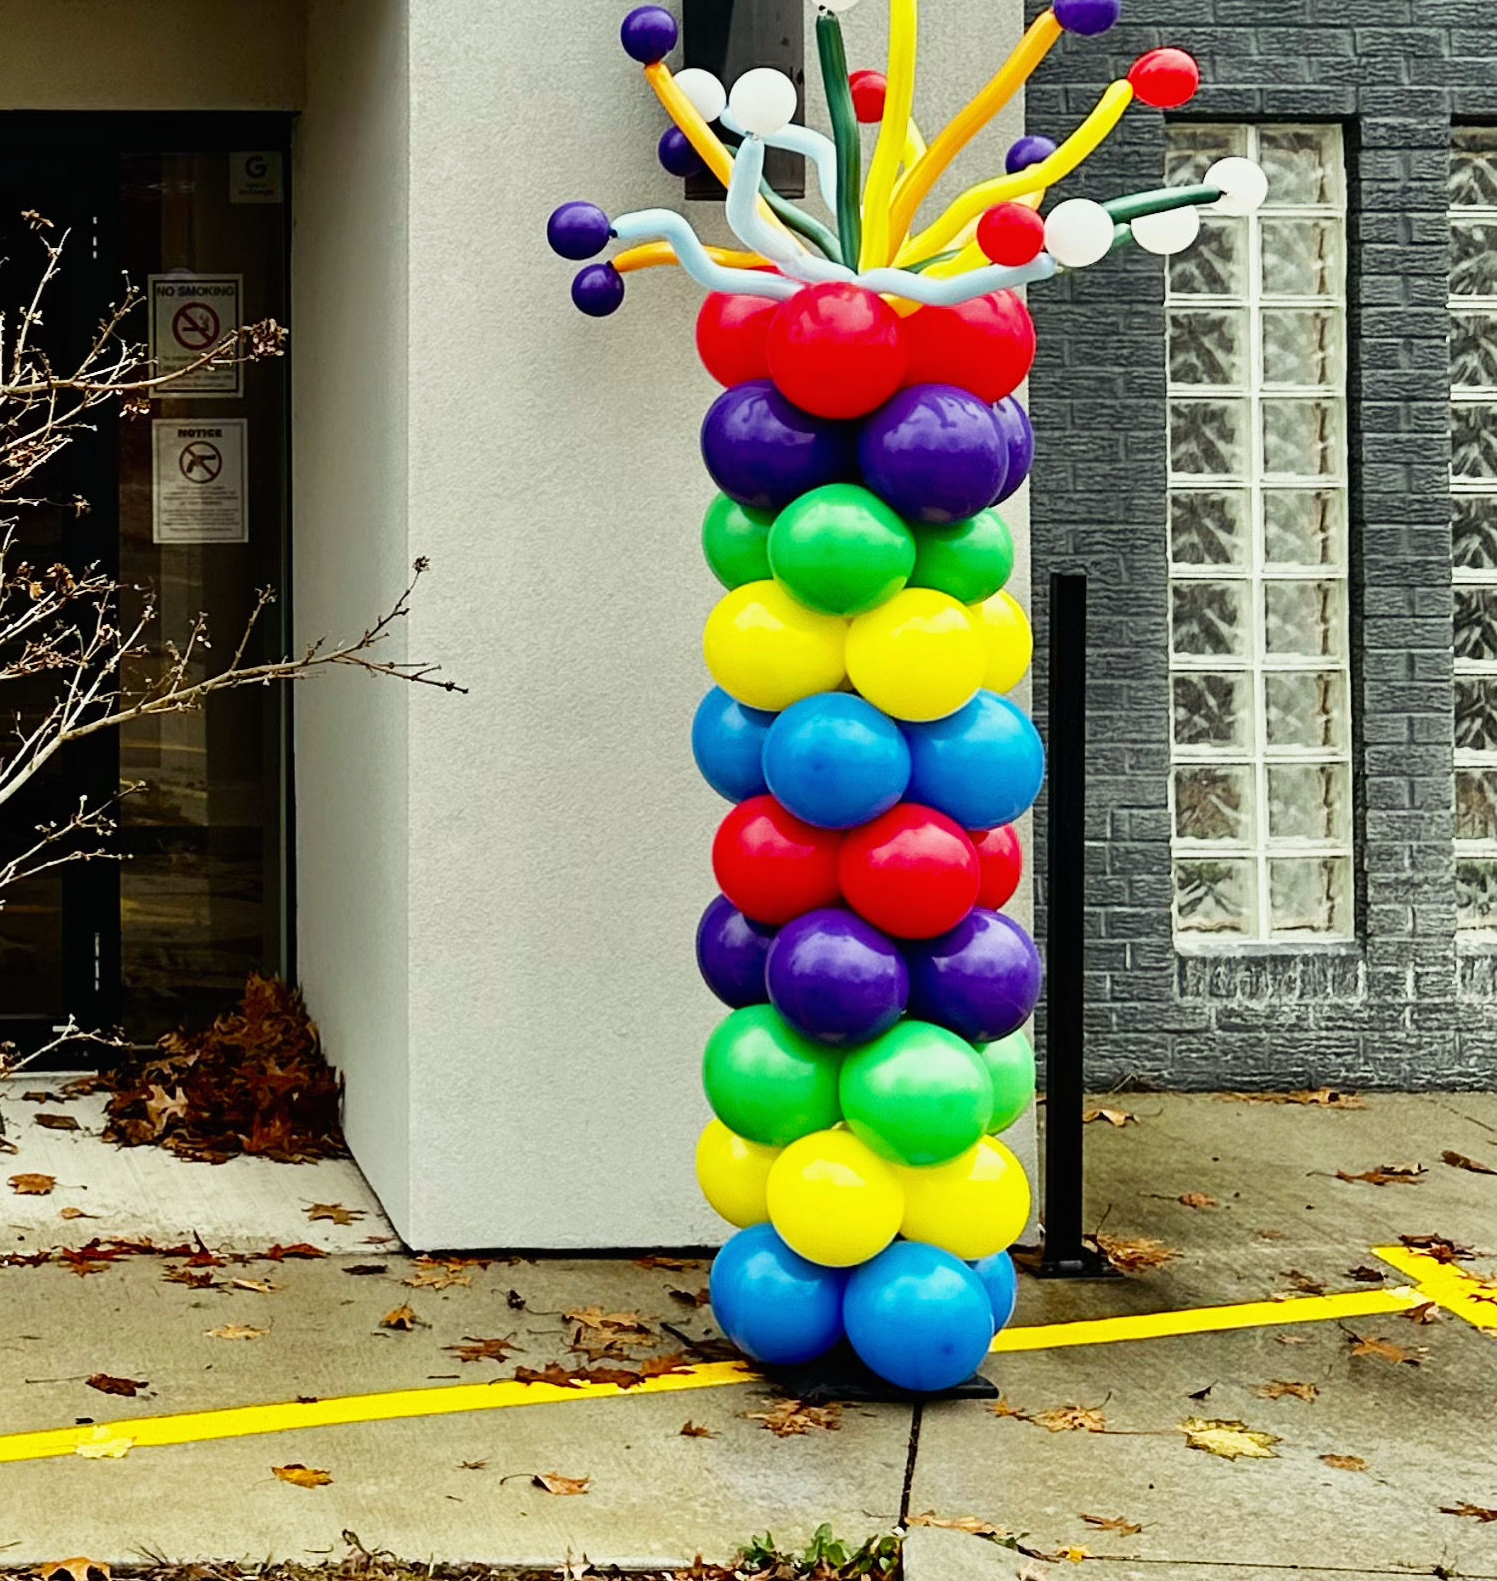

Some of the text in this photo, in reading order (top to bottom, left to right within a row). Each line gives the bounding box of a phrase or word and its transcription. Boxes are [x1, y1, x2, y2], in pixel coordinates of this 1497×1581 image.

[156, 285, 235, 297] NO SMOKING
[177, 428, 223, 438] NOTICE
